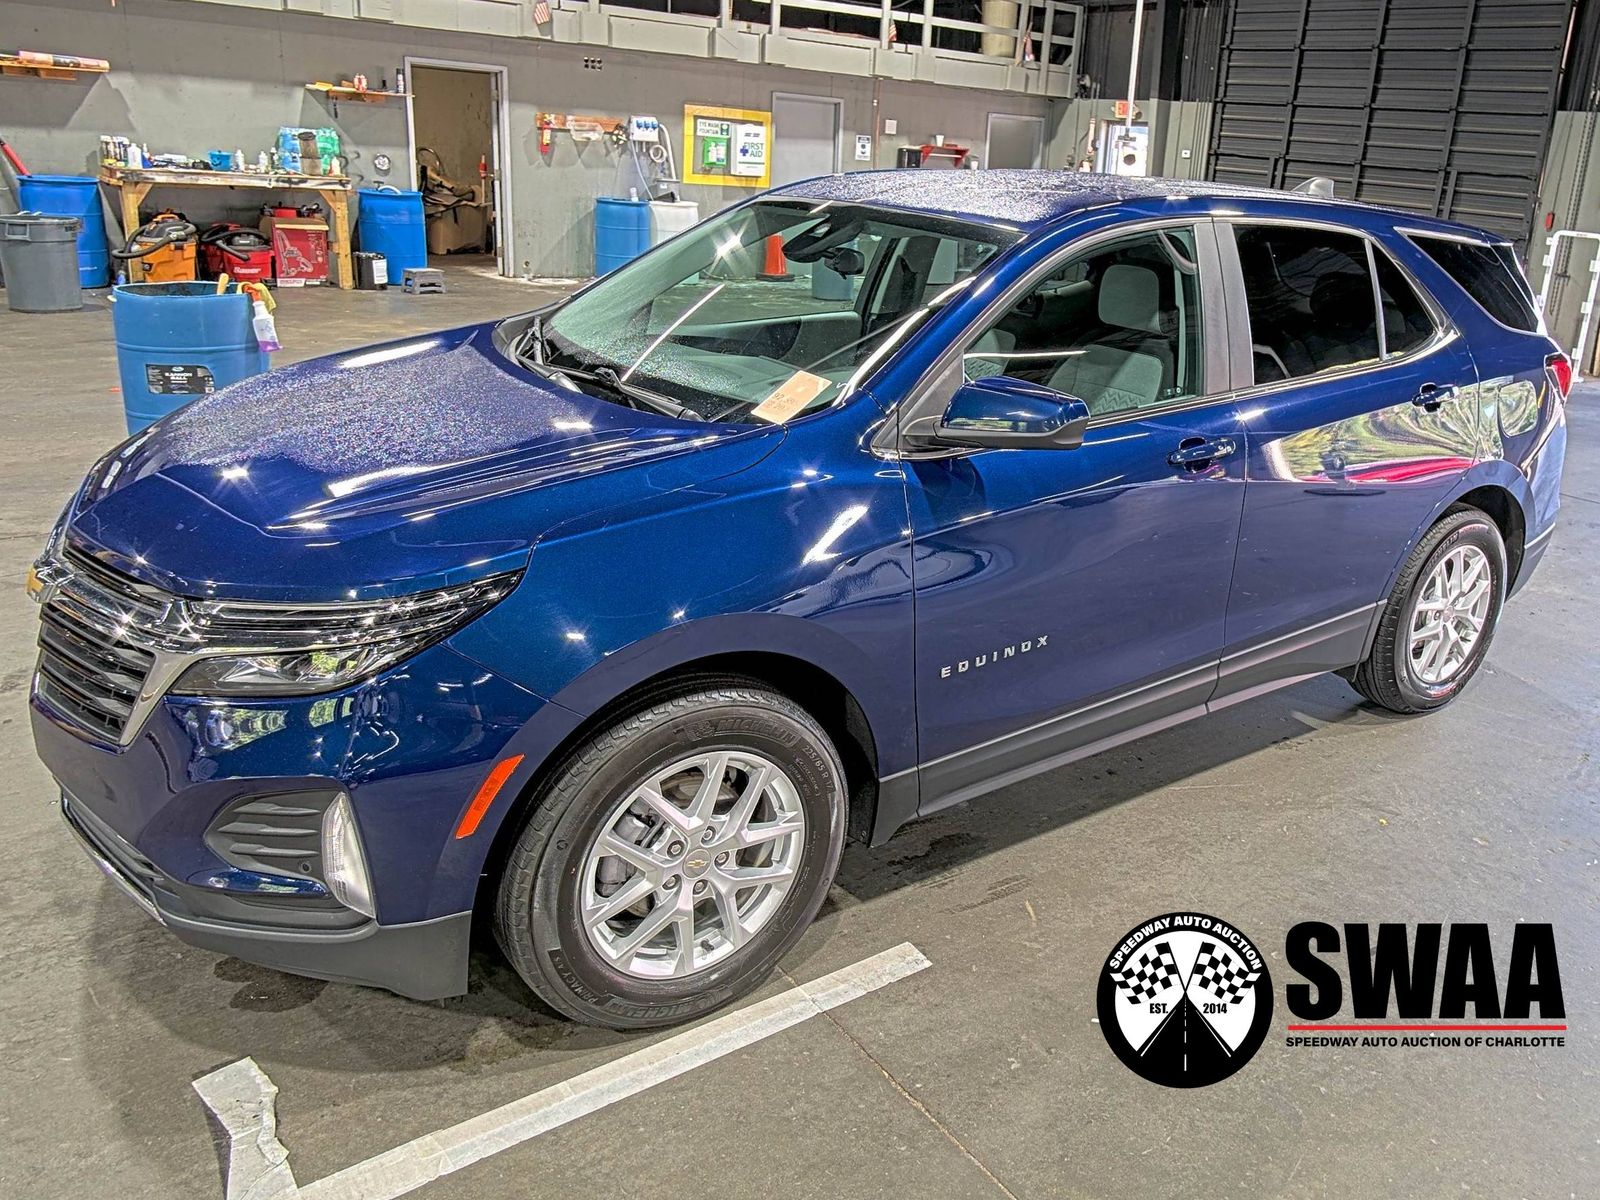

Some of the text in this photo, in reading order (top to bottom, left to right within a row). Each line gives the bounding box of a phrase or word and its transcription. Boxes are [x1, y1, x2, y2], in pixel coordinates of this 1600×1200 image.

[744, 142, 764, 151] FIRST
[941, 635, 1048, 678] EQUINOX
[717, 718, 798, 748] MICHELIN
